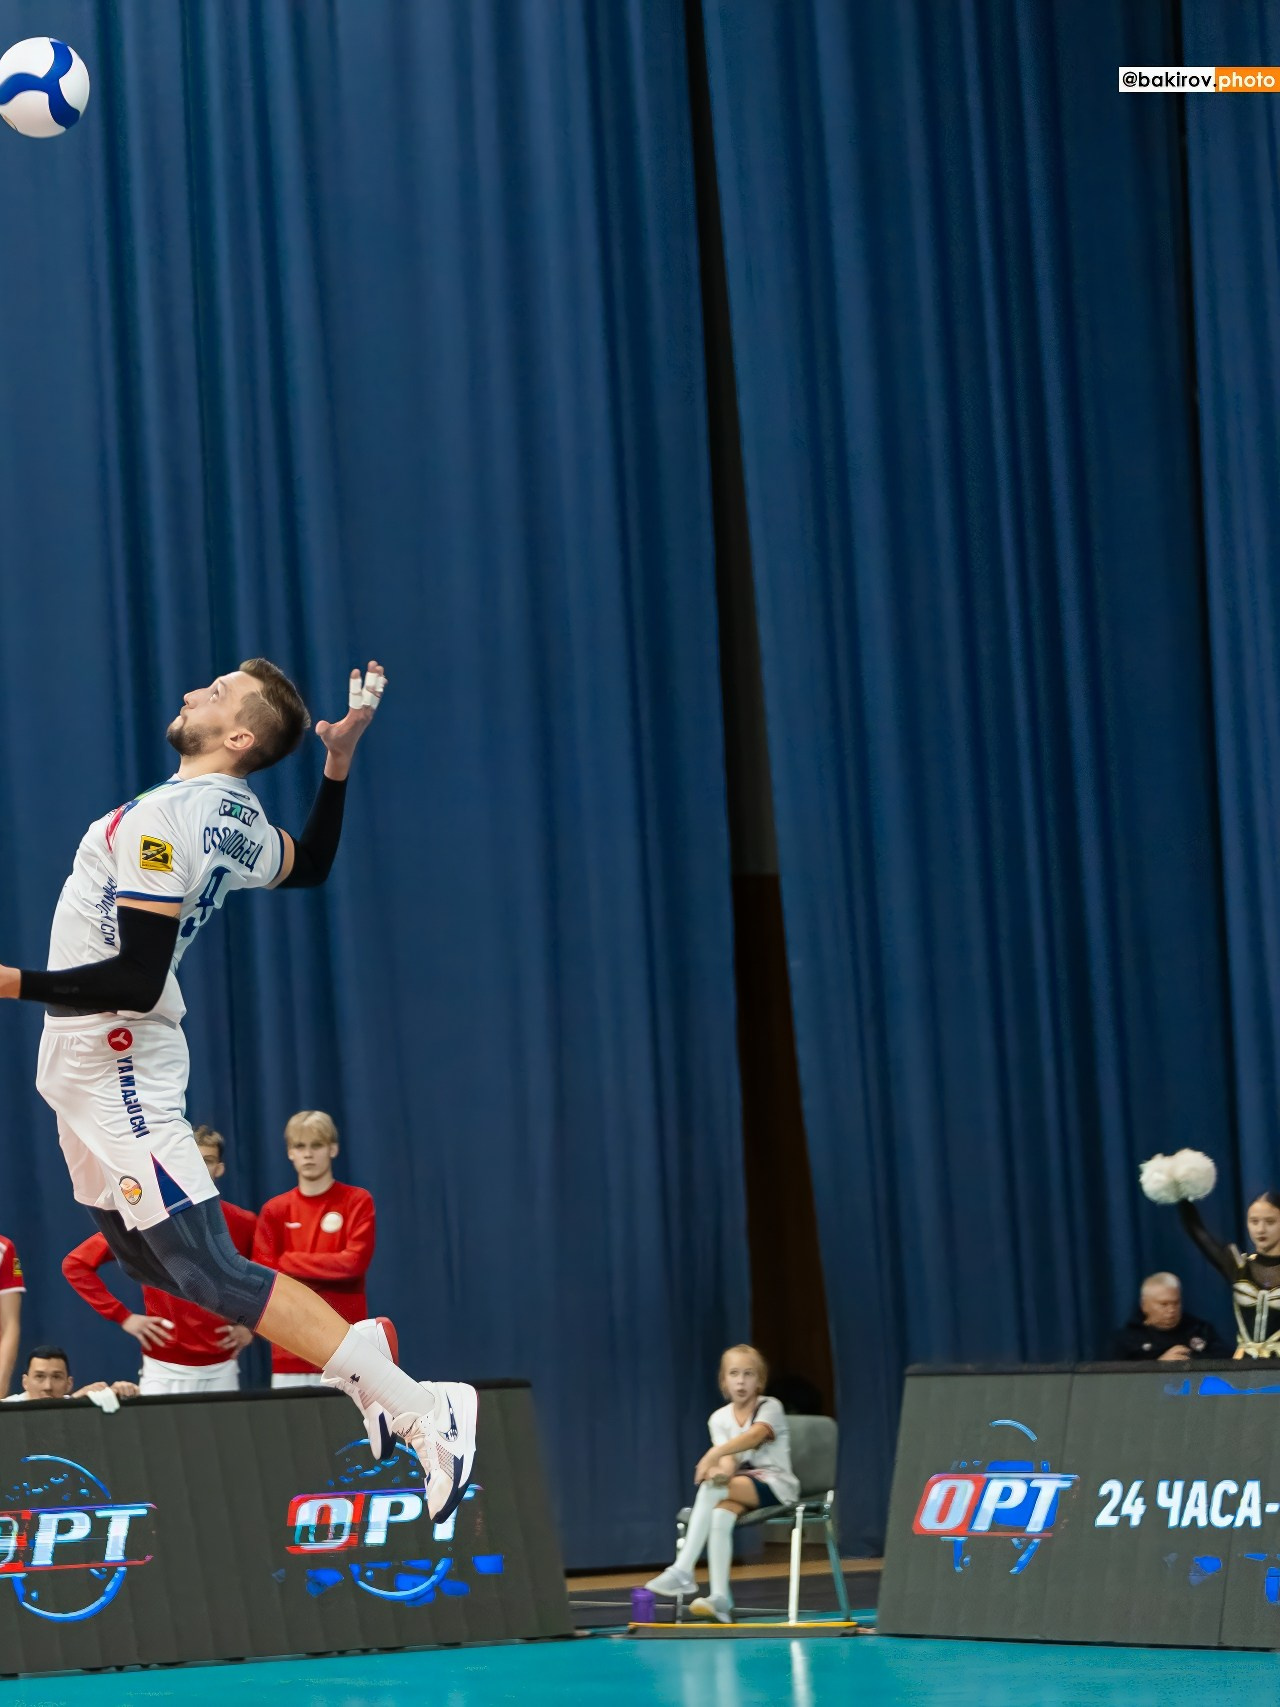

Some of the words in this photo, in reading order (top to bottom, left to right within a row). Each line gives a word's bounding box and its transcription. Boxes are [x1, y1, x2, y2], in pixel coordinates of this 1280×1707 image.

[220, 800, 258, 827] PARI
[918, 1477, 1073, 1534] ОРТ
[1095, 1479, 1147, 1528] 24
[1157, 1479, 1280, 1528] ЧАСА-
